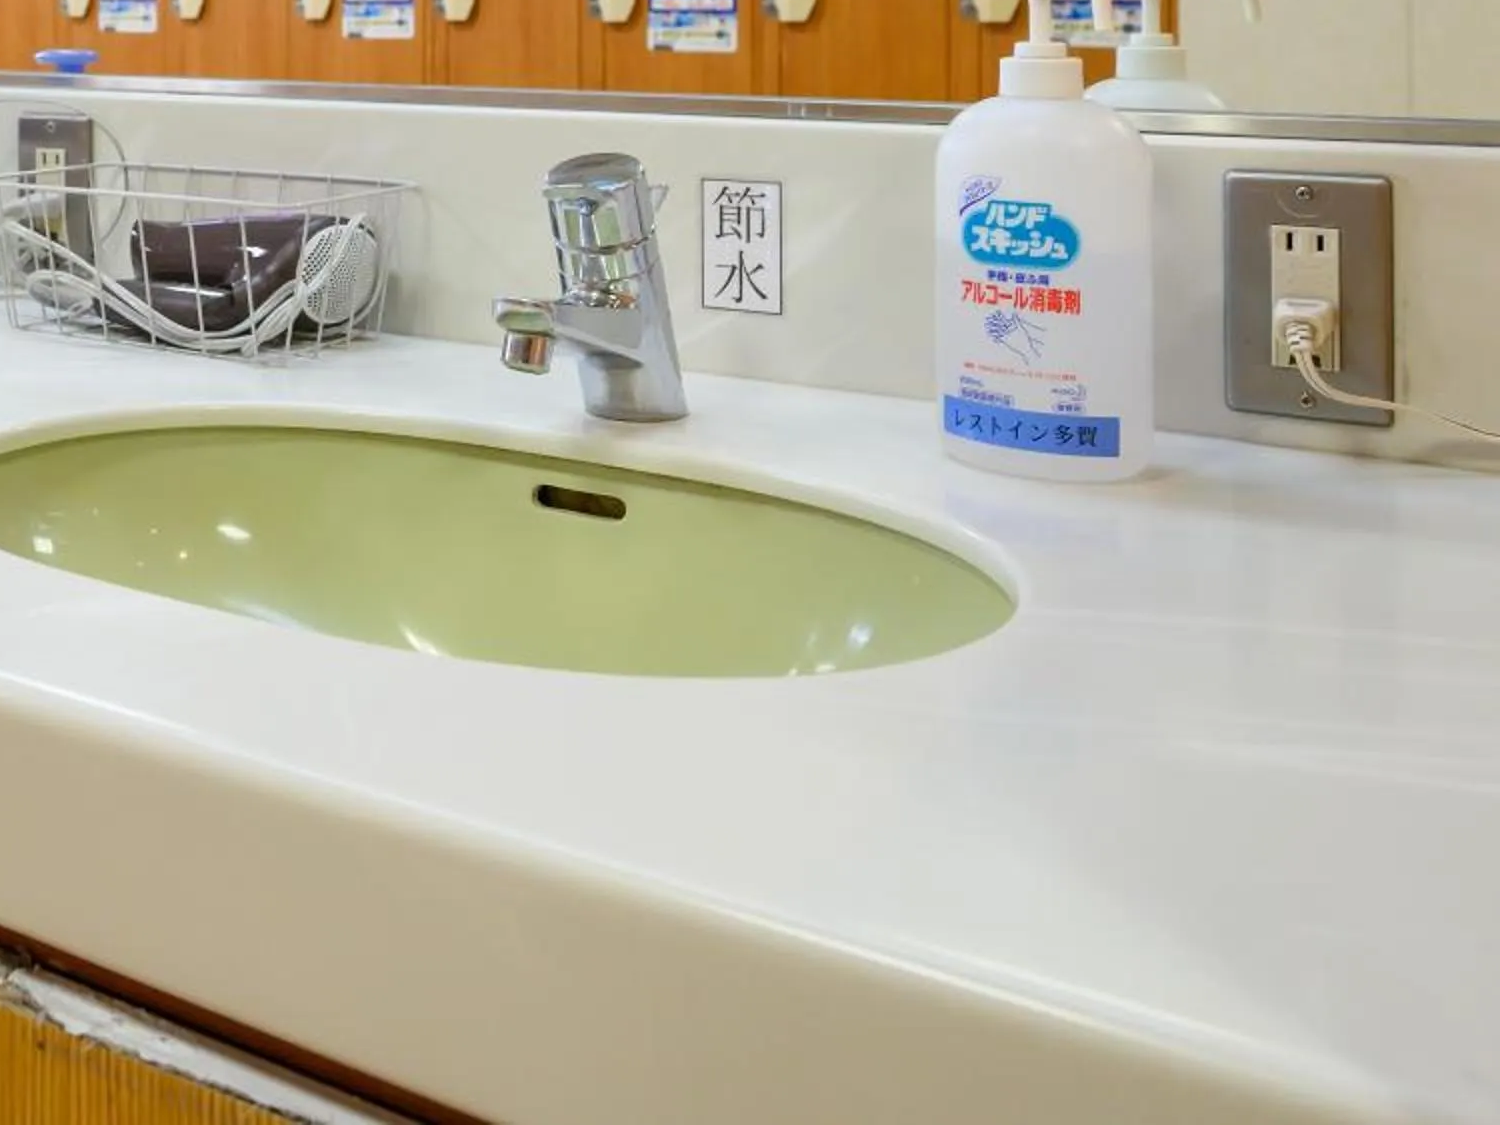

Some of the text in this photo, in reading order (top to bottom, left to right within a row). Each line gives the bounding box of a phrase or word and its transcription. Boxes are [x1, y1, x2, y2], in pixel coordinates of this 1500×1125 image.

[985, 202, 1050, 230] ハンド
[712, 186, 768, 303] 節水
[970, 225, 1070, 261] スキッシュ
[961, 278, 1082, 316] アルコール消毒剤
